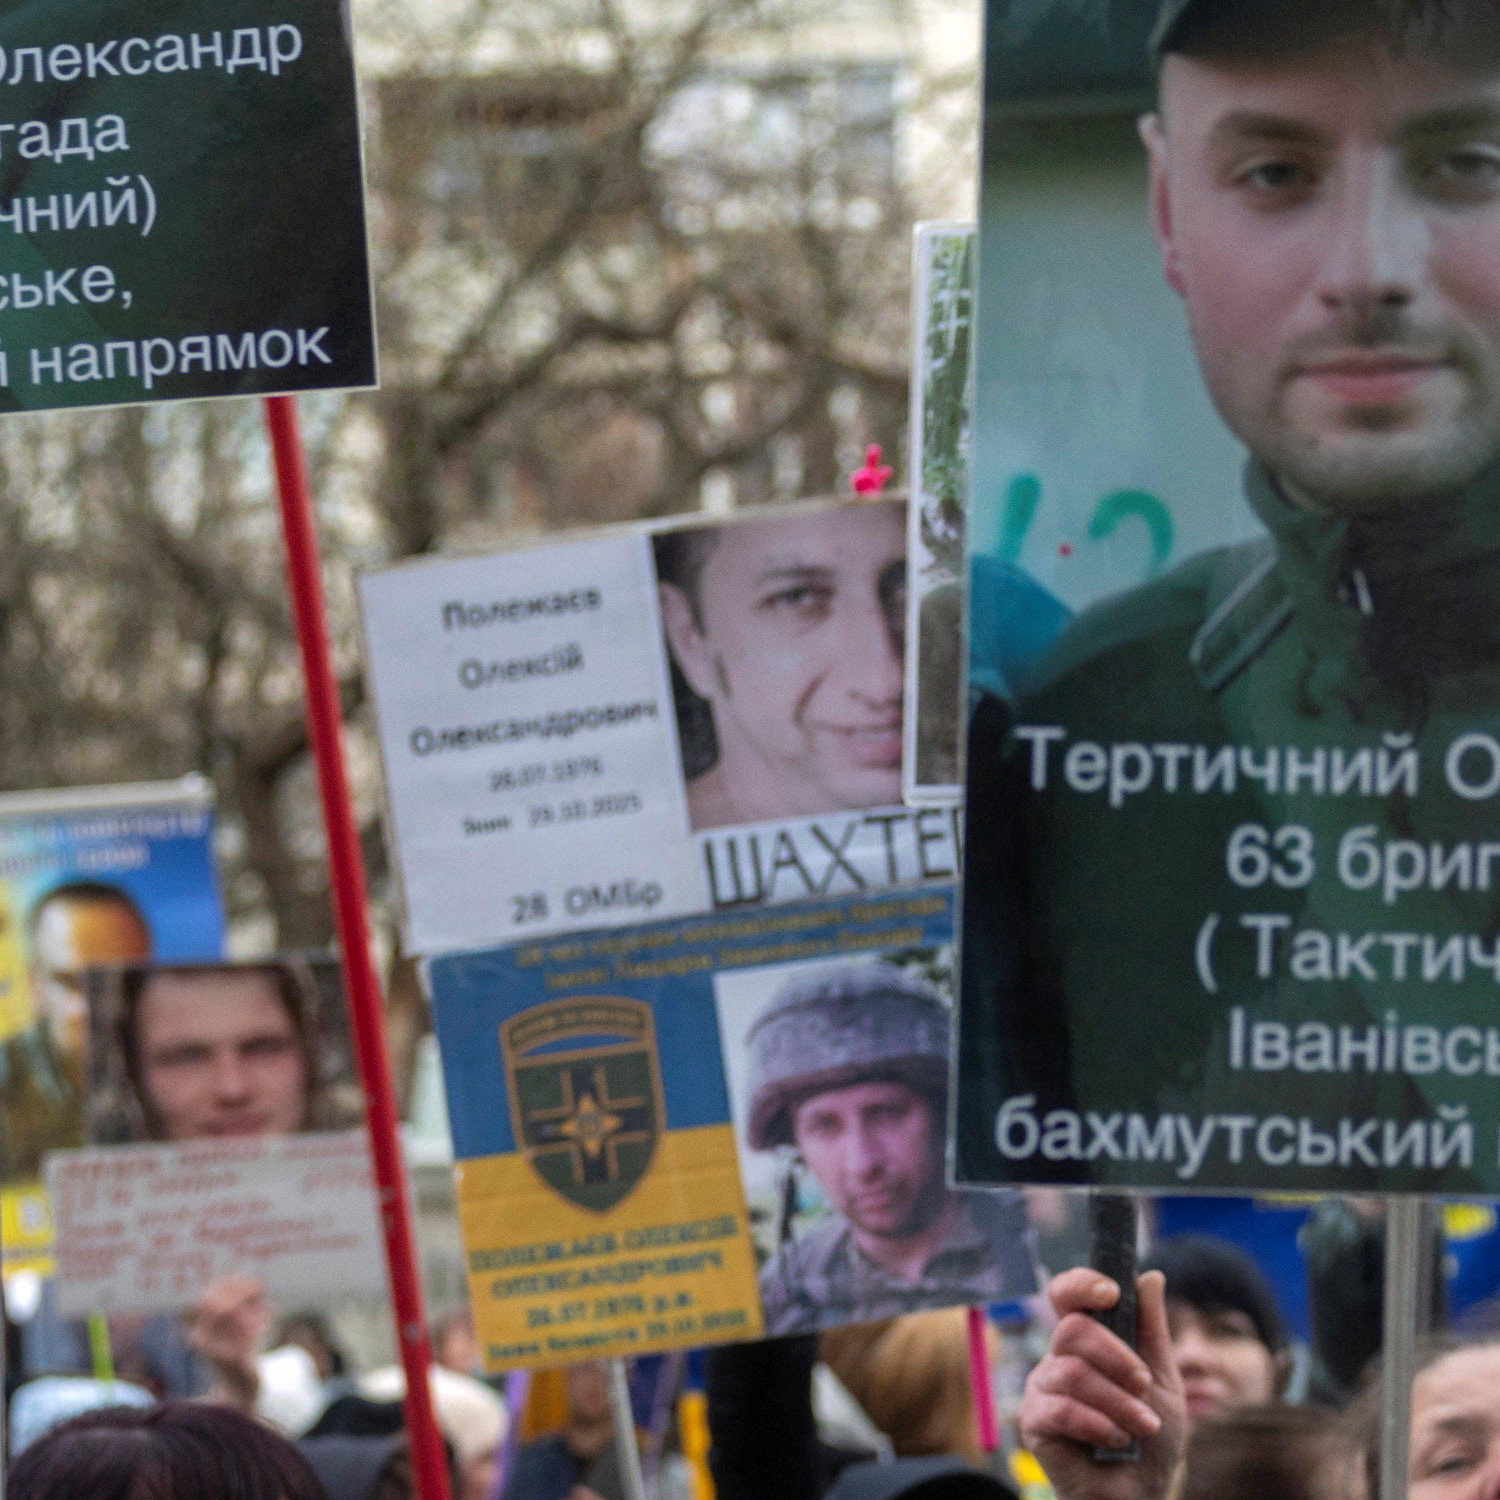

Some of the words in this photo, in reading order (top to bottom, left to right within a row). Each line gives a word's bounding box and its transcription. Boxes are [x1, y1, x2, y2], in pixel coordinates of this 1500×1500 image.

[28, 326, 331, 390] напрямок
[458, 642, 585, 690] Олексій
[409, 699, 659, 757] Олександрович
[1015, 726, 1421, 808] Тертичний
[703, 805, 963, 908] ШАХТЕ
[1226, 823, 1314, 887] 63
[994, 1094, 1475, 1178] бахмутський
